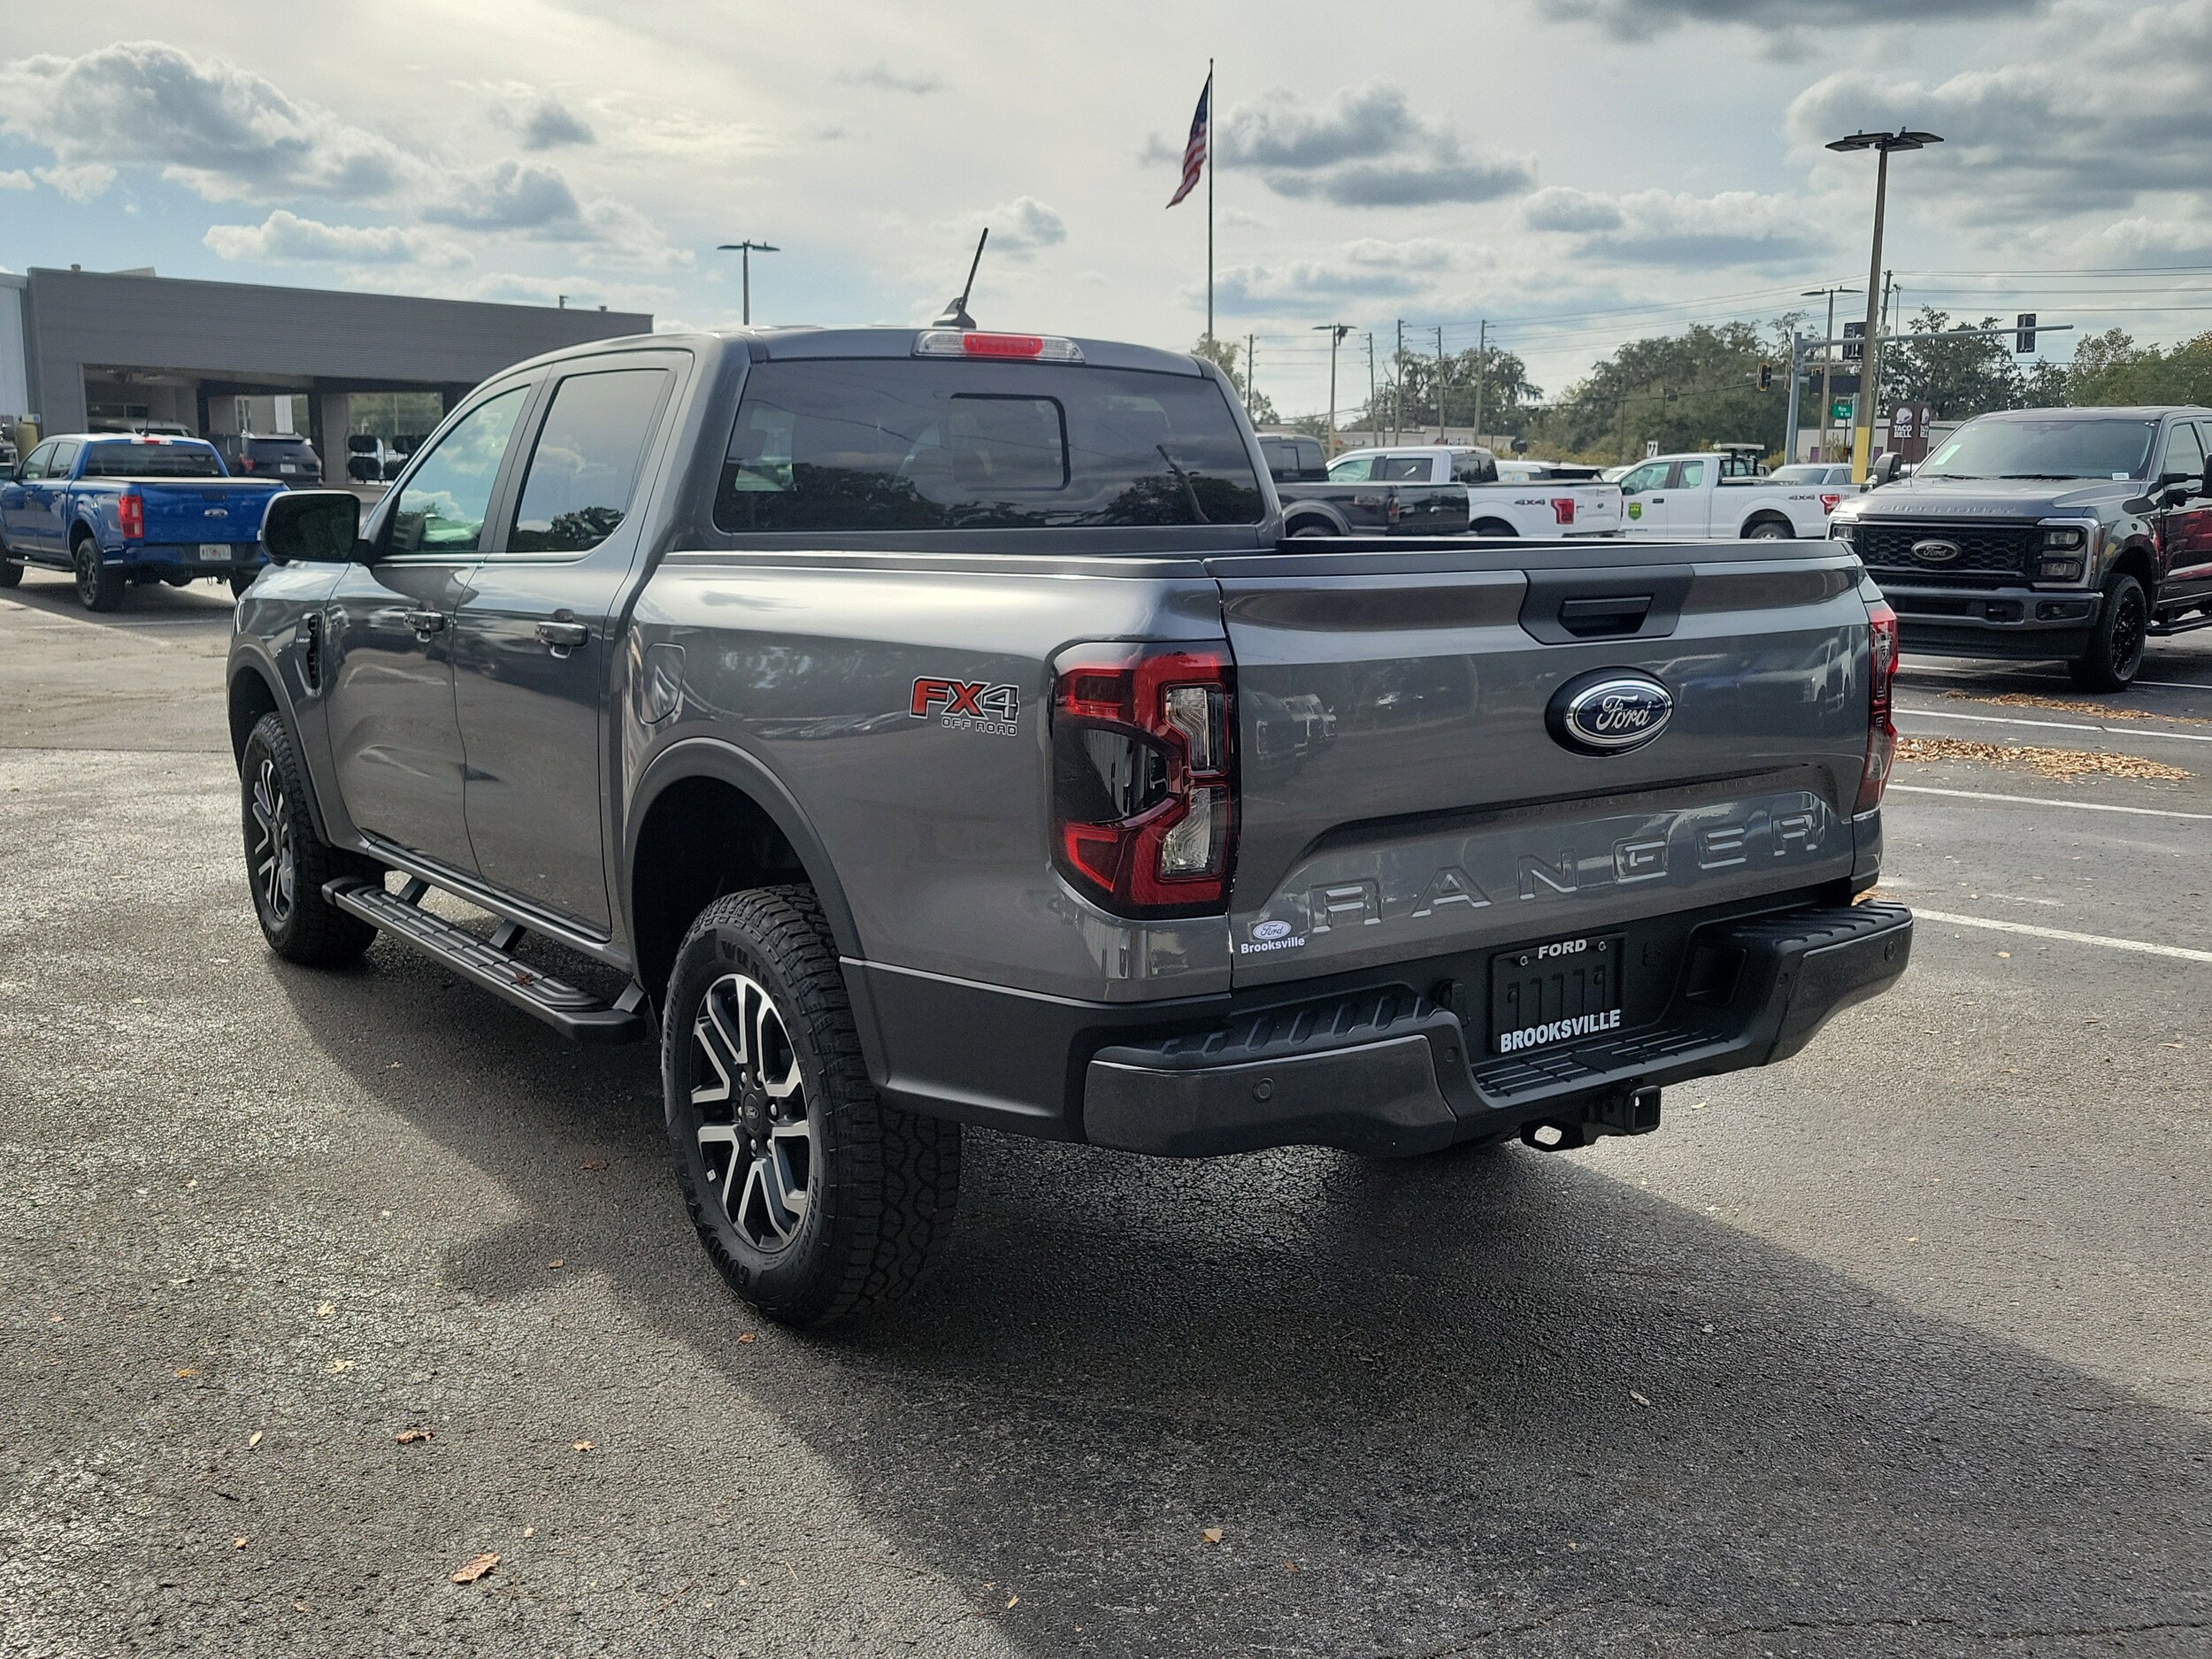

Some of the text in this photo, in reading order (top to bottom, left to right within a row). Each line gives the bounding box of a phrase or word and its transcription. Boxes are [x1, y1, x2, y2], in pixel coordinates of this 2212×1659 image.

[1923, 545, 1948, 557] Ford
[910, 675, 1020, 724] FX4
[1595, 695, 1652, 731] Ford
[941, 717, 1017, 737] OFF ROAD
[1309, 809, 1819, 933] RANGER
[1260, 924, 1285, 936] Ford
[1240, 937, 1305, 954] Brooksville
[1538, 939, 1587, 959] FORD
[1501, 1009, 1621, 1053] BROOKSVILLE
